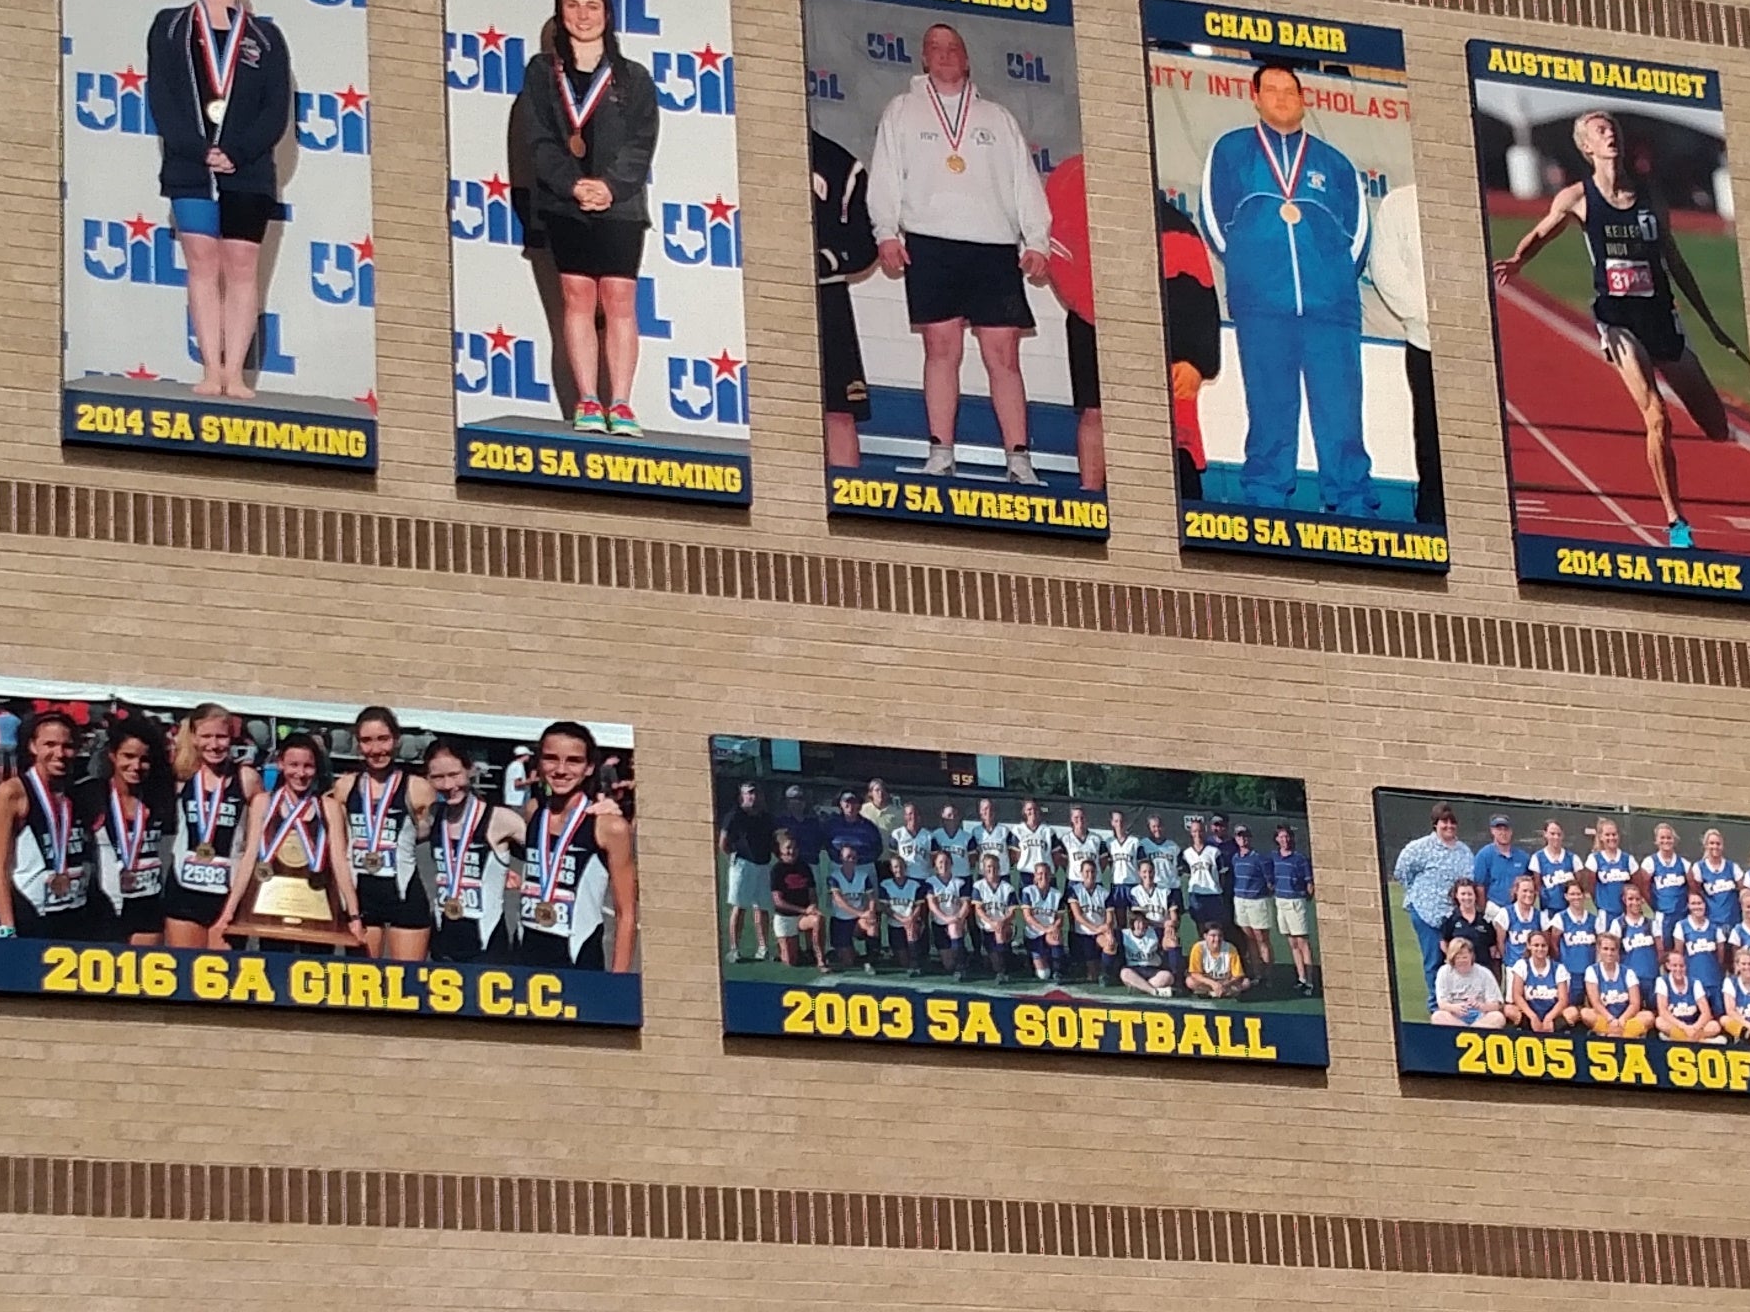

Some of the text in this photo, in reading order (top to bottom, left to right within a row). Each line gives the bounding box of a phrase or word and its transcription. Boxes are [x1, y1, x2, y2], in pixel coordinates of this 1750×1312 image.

[1205, 11, 1346, 51] CHAD BAHR
[1489, 49, 1705, 97] AUSTEN DALQUIST
[77, 405, 367, 458] 2014 5A SWIMMING
[470, 441, 742, 492] 2013 5A SWIMMING
[834, 478, 1108, 529] 2007 5A WRESTLING
[1186, 511, 1448, 563] 2006 5A WRESTLING
[1558, 548, 1742, 590] 2014 5A TRACK
[183, 863, 227, 884] 2593
[42, 946, 576, 1019] 2016 6A GIRL'S C.C.
[783, 990, 1277, 1060] 2003 5A SOFTBALL
[1455, 1031, 1577, 1079] 2005
[1586, 1041, 1658, 1085] 5A
